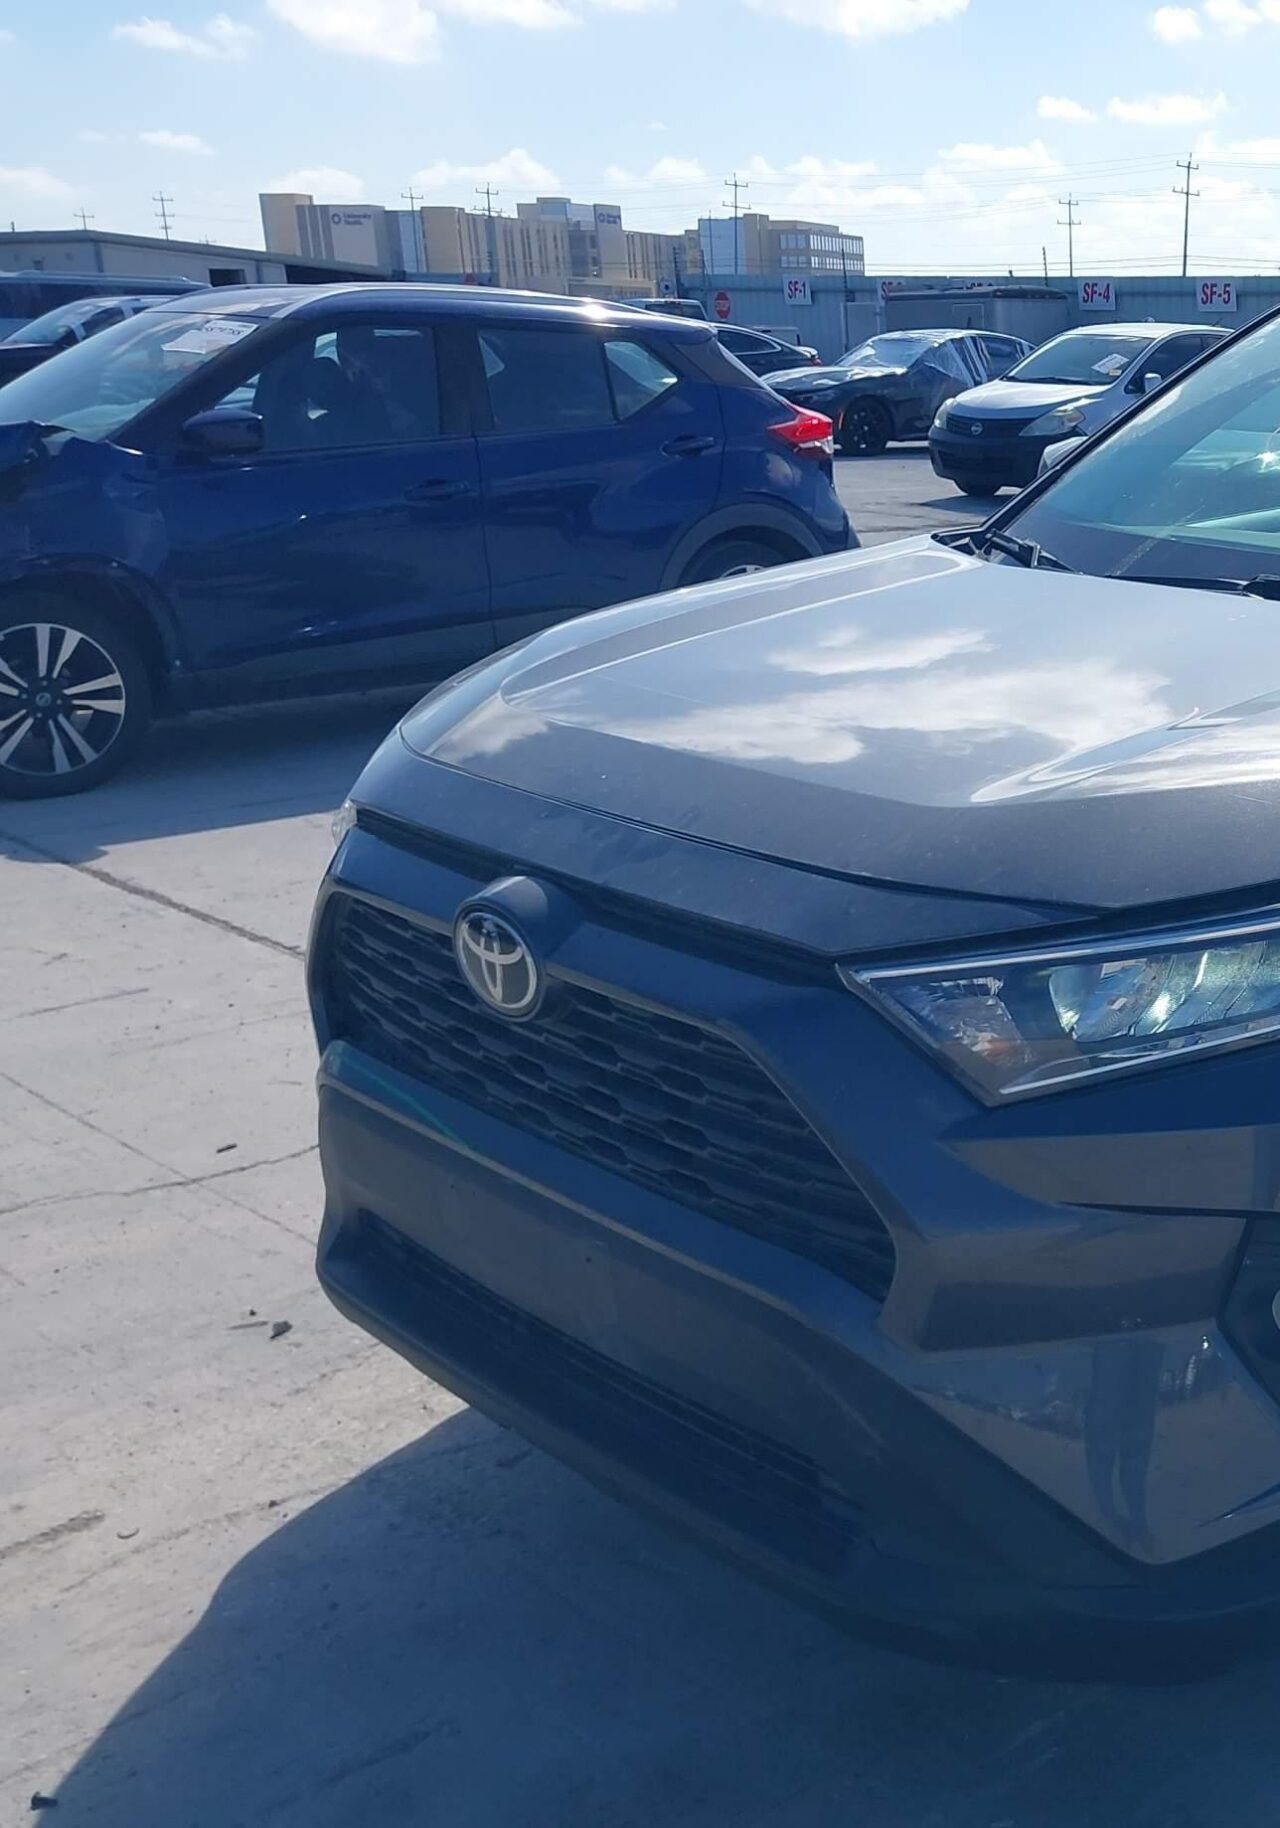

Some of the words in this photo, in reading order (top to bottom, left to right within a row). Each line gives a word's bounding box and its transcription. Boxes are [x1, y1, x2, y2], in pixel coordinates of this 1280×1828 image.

[787, 280, 807, 300] SF-1
[1082, 282, 1111, 304] SF-4
[1201, 282, 1231, 305] SF-5
